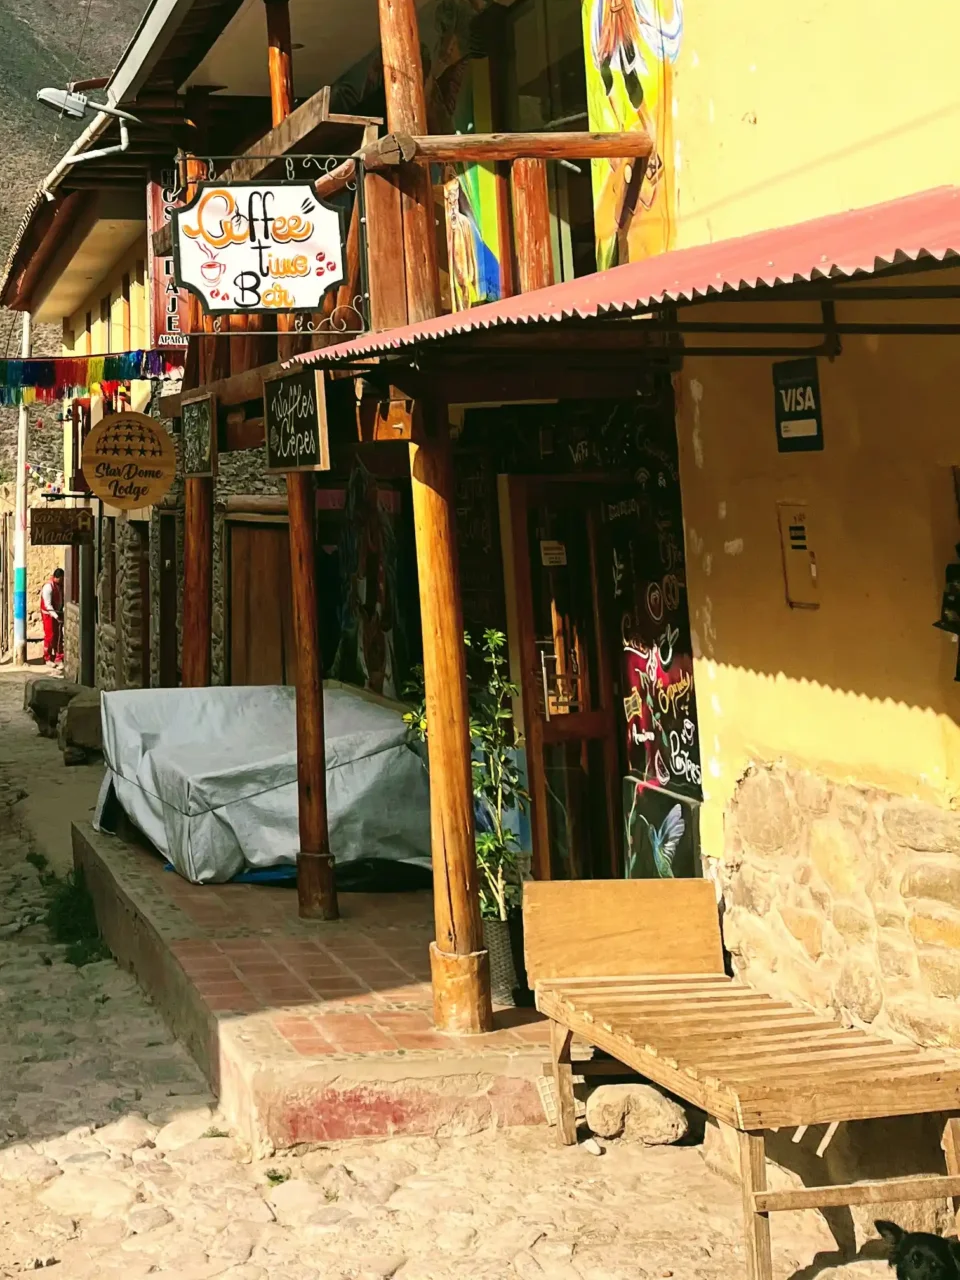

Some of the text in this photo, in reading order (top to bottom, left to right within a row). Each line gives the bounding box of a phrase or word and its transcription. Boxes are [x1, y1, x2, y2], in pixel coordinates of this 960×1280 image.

[182, 190, 314, 248] Coffee
[234, 271, 295, 308] Bar
[271, 382, 315, 428] Waffles
[779, 386, 816, 412] VISA
[108, 480, 149, 501] Lodge
